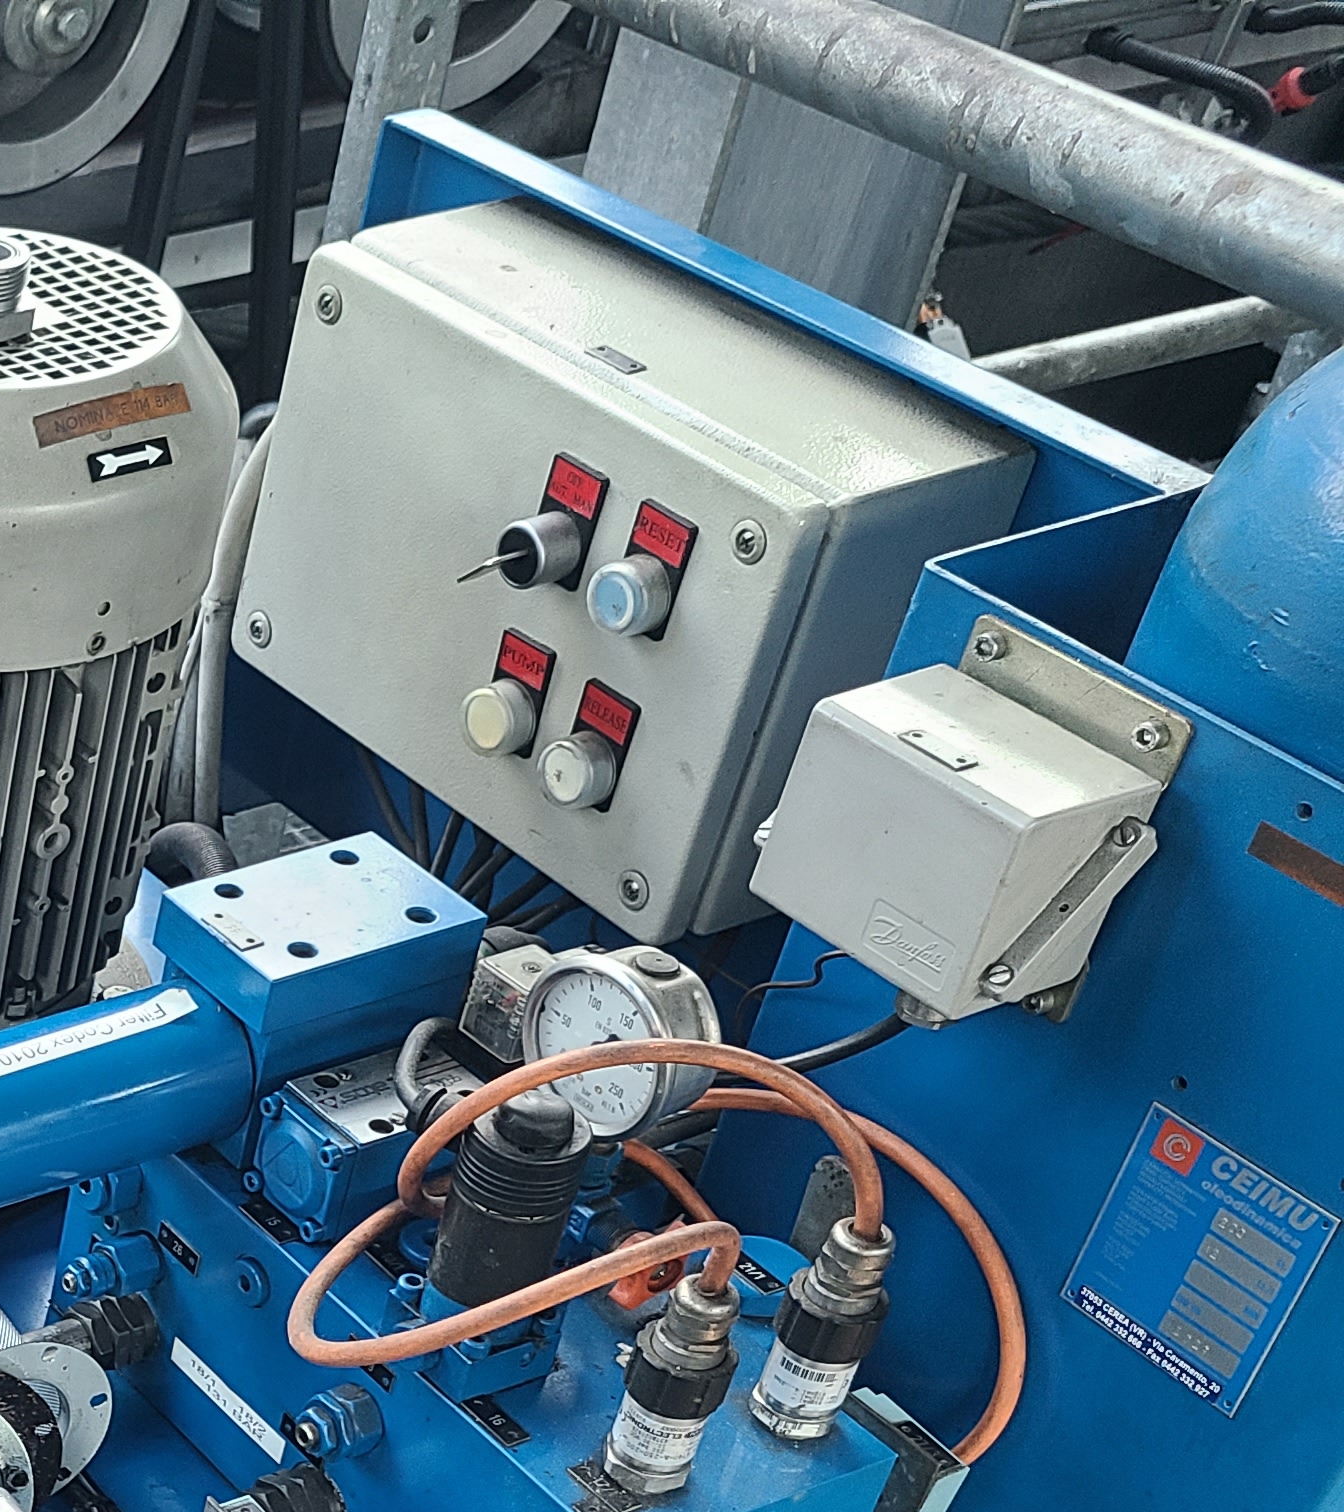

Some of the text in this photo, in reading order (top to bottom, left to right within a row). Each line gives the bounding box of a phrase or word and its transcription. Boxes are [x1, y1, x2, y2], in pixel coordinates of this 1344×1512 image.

[640, 515, 687, 554] RESET
[502, 644, 544, 676] PUMP
[583, 696, 627, 735] RELEASE
[869, 915, 946, 974] Danfoss
[119, 1002, 168, 1029] Filter
[587, 994, 602, 1011] 100
[561, 1014, 572, 1028] 50
[619, 1012, 634, 1030] 150
[52, 1024, 115, 1049] Codex
[608, 1082, 624, 1099] 250
[1211, 1155, 1319, 1231] CEIMU
[264, 1215, 281, 1227] 15
[1201, 1180, 1303, 1249] oleodinamica
[738, 1262, 767, 1280] 21/1
[1081, 1300, 1094, 1315] Tel.
[1095, 1310, 1113, 1329] 0442
[1145, 1348, 1162, 1364] Fax
[1161, 1358, 1181, 1377] 0442
[1102, 1304, 1130, 1327] CEREA
[1129, 1323, 1148, 1340] (VR)
[1151, 1338, 1165, 1353] Via
[191, 1359, 216, 1387] 18/1
[488, 1414, 506, 1426] 16
